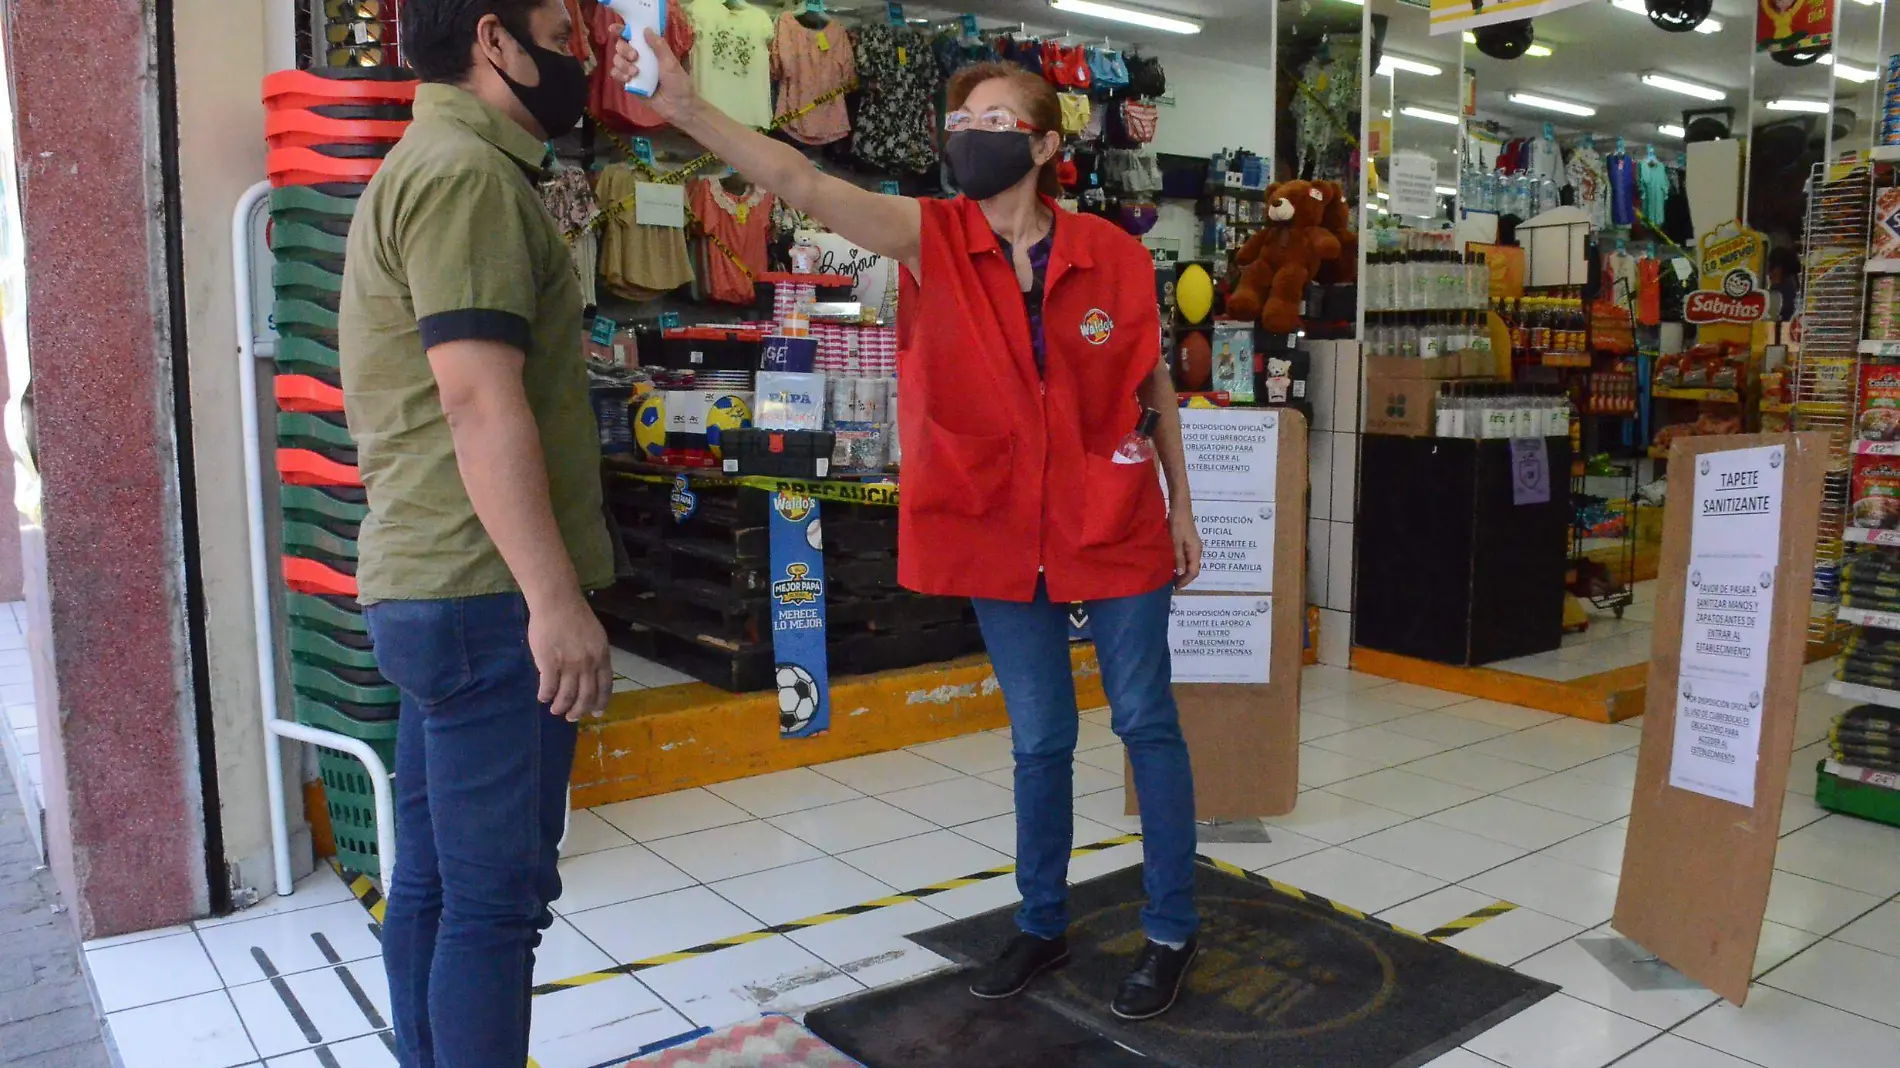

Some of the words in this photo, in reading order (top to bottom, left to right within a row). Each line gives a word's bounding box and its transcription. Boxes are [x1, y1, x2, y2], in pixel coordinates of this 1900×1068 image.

[1692, 295, 1760, 318] Sabritas
[1080, 318, 1114, 337] Waldo's
[1238, 424, 1264, 432] OFICIAL
[1210, 434, 1256, 442] CUBREBOCAS
[1186, 444, 1234, 452] OBLIGATORIO
[1234, 444, 1254, 452] PARA
[1231, 454, 1239, 462] AL
[1720, 470, 1758, 487] TAPETE
[773, 496, 816, 510] Waldo's
[1703, 496, 1770, 513] SANITIZANTE
[1202, 516, 1253, 524] DISPOSICIÓN
[1202, 528, 1232, 536] OFICIAL
[1210, 562, 1228, 570] POR
[1228, 563, 1262, 571] FAMILIA
[775, 582, 801, 592] MEJOR
[1700, 584, 1719, 593] FAVOR
[1720, 584, 1728, 594] DE
[1730, 585, 1751, 594] PASAR
[1752, 586, 1757, 594] A
[1696, 598, 1726, 608] SANITIZAR
[1728, 600, 1752, 610] MANOS
[1754, 602, 1759, 610] Y
[778, 608, 818, 620] MERECE
[1186, 609, 1230, 617] DISPOSICIÓN
[774, 620, 787, 631] LO
[790, 618, 822, 630] MEJOR
[1696, 613, 1722, 623] ZAPATOS
[1724, 615, 1746, 625] ANTES
[1746, 616, 1756, 626] DE
[1708, 628, 1731, 639] ENTRAR
[1734, 631, 1740, 640] AL
[1216, 648, 1253, 656] PERSONAS
